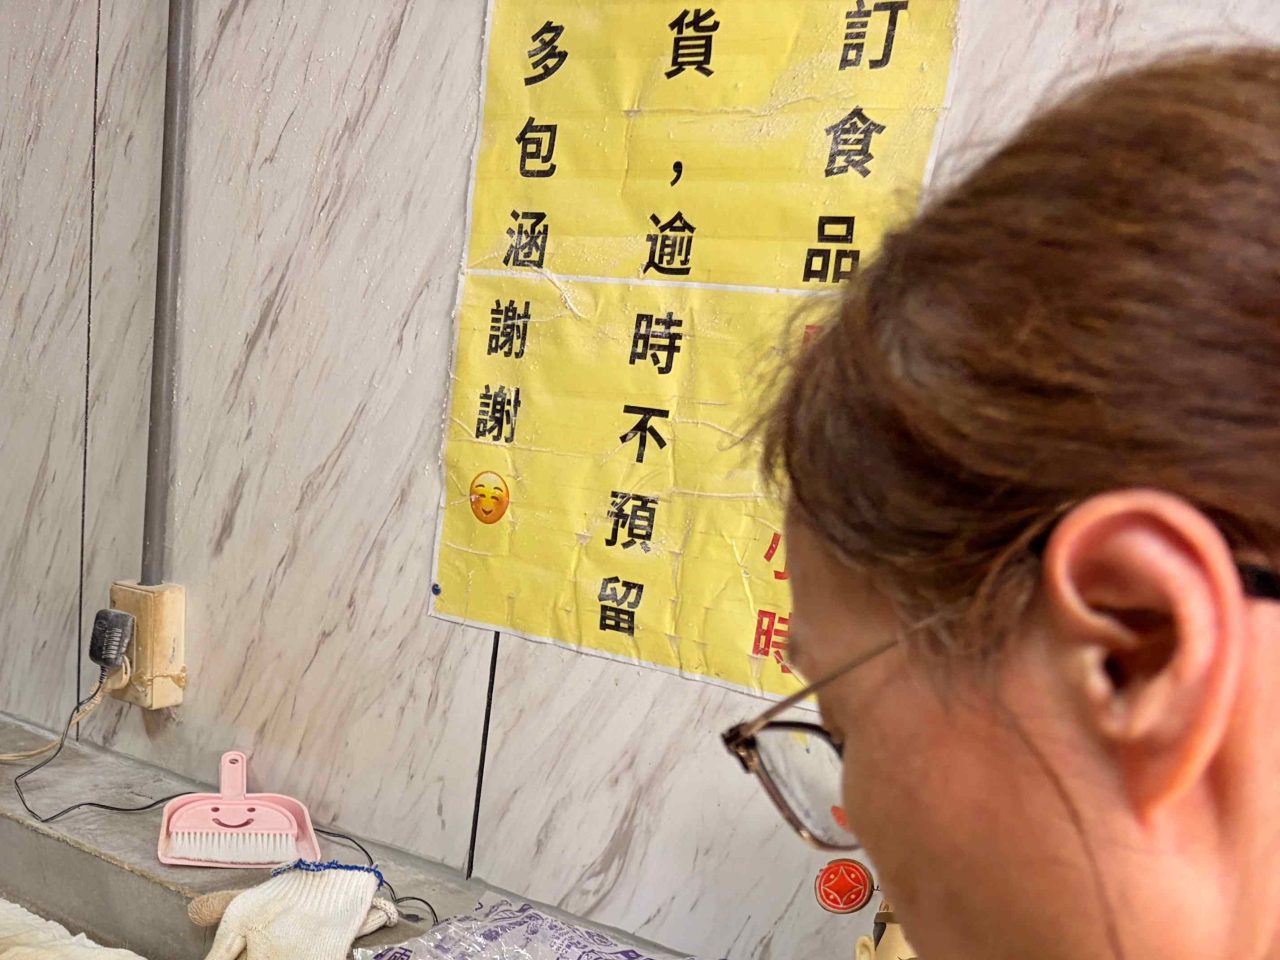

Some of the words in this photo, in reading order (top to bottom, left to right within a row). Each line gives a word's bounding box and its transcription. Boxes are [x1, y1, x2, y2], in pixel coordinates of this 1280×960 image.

[474, 20, 569, 444] 多包涵謝謝
[803, 0, 910, 284] 訂食品
